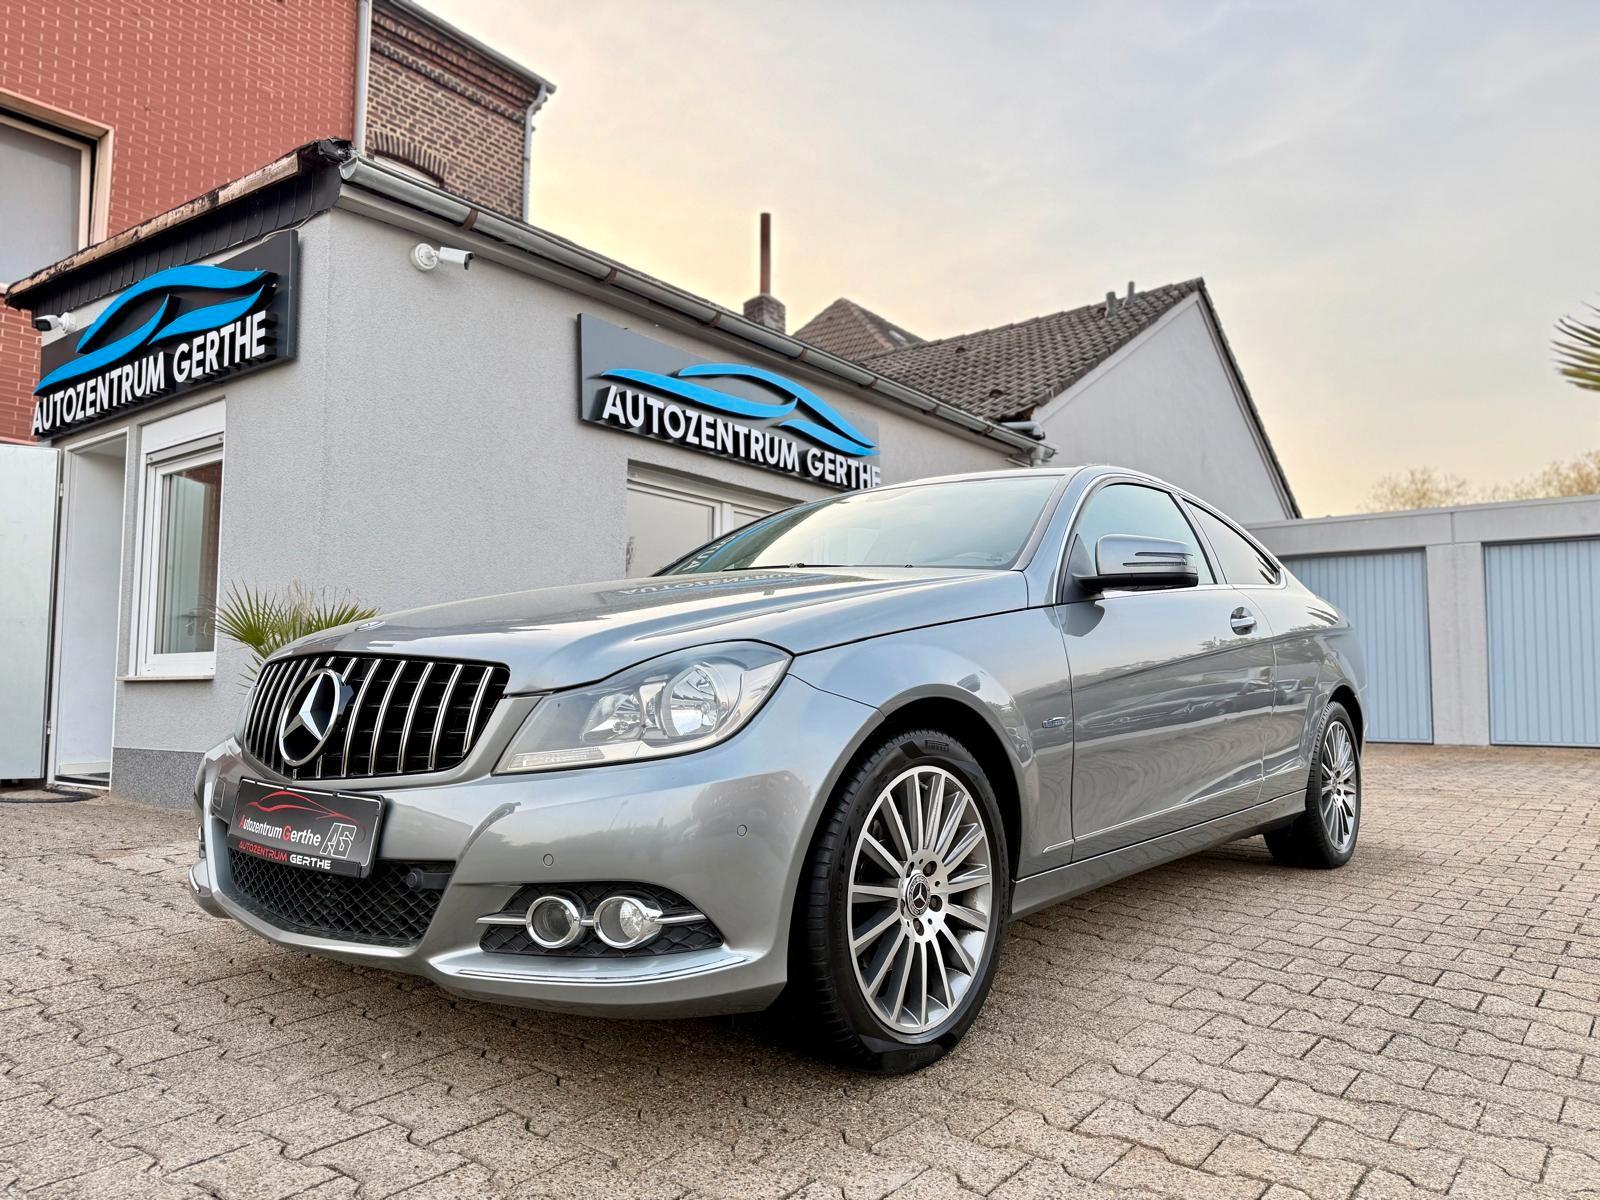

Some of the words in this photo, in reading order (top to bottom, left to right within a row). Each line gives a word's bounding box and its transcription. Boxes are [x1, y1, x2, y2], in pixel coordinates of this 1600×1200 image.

[31, 352, 165, 436] AUTOZENTRUM
[173, 310, 266, 383] GERTHE
[602, 385, 800, 472] AUTOZENTRUM
[807, 447, 880, 490] GERTHE
[239, 815, 283, 839] Autozentrum
[282, 825, 321, 847] Gerthe
[239, 841, 288, 862] AUTOZENTRUM
[289, 853, 332, 870] GERTHE
